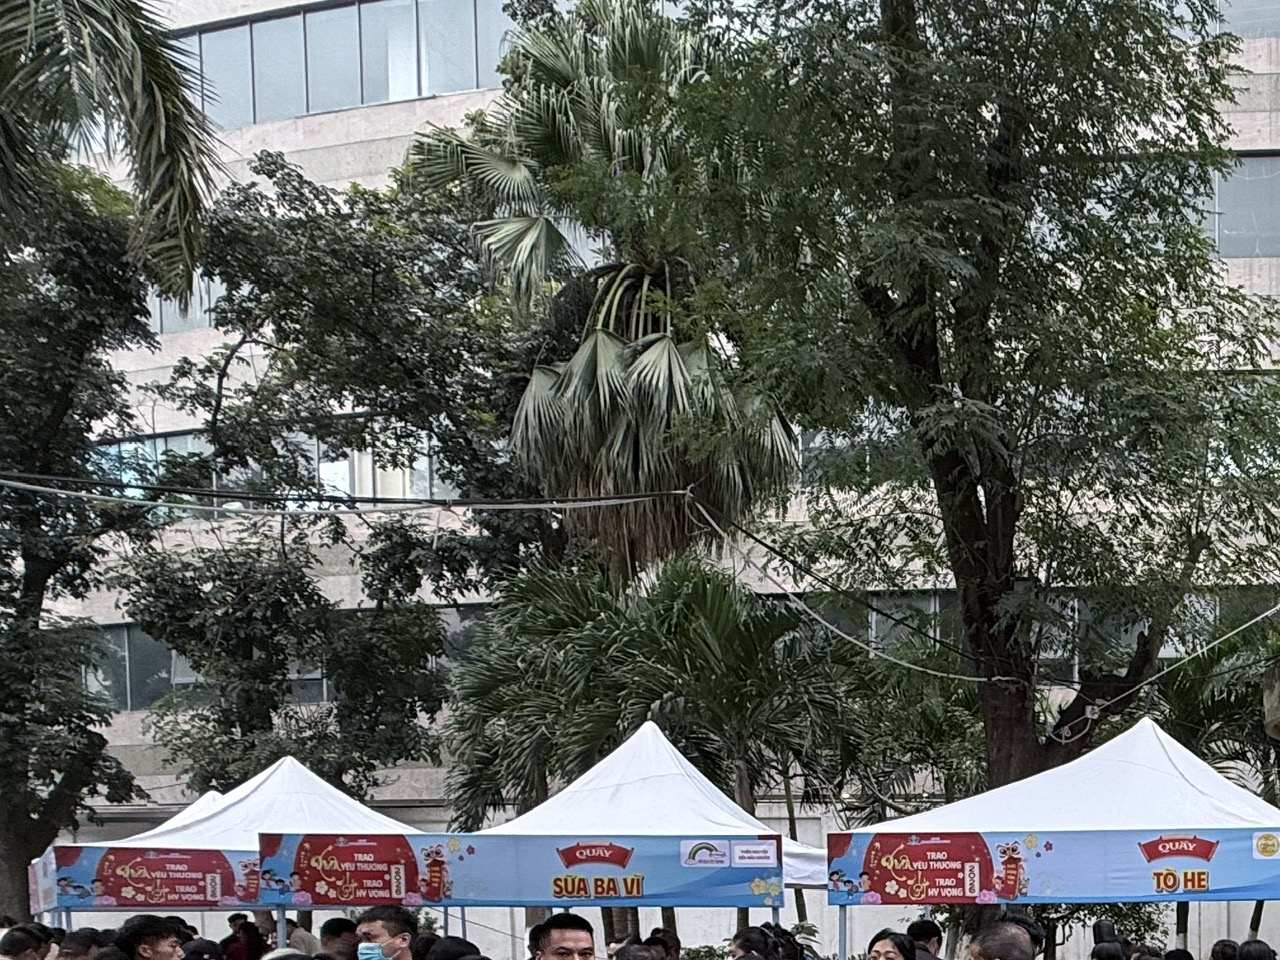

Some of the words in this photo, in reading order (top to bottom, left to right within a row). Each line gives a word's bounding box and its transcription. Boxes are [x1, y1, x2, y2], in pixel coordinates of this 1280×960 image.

[353, 853, 374, 861] TRAO
[926, 852, 948, 860] TRAO
[935, 878, 956, 886] TRAO
[968, 865, 976, 894] 2026
[1153, 868, 1178, 889] TÒ
[1184, 871, 1207, 889] HE
[363, 880, 383, 888] TRAO
[552, 874, 589, 896] SỮA
[594, 877, 618, 896] BA
[623, 873, 643, 896] VÌ
[175, 885, 197, 893] TRAO
[927, 888, 939, 897] HY
